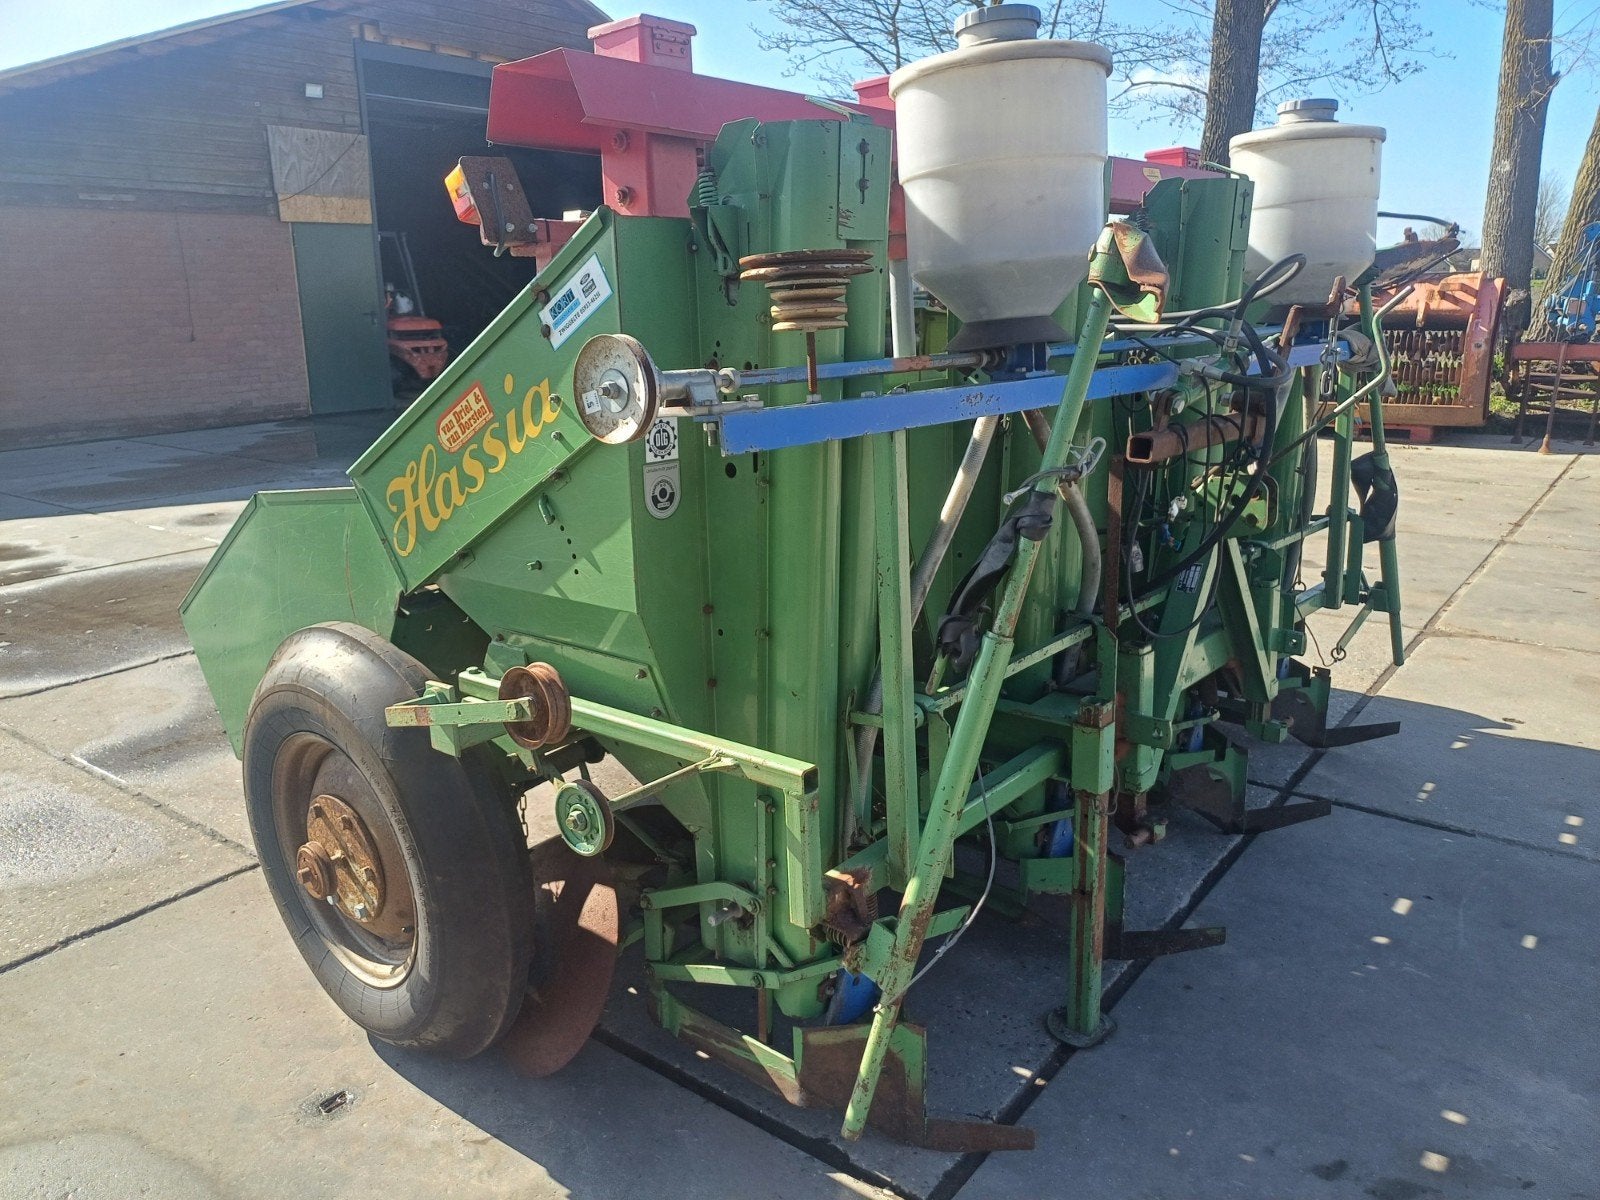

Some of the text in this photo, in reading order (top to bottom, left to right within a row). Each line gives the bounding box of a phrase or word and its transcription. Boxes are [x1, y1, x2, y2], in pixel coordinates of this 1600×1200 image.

[549, 288, 575, 320] KORT
[441, 391, 482, 435] van Driel &
[446, 431, 461, 446] van
[458, 405, 487, 435] Dorsten
[386, 373, 563, 557] Hassia
